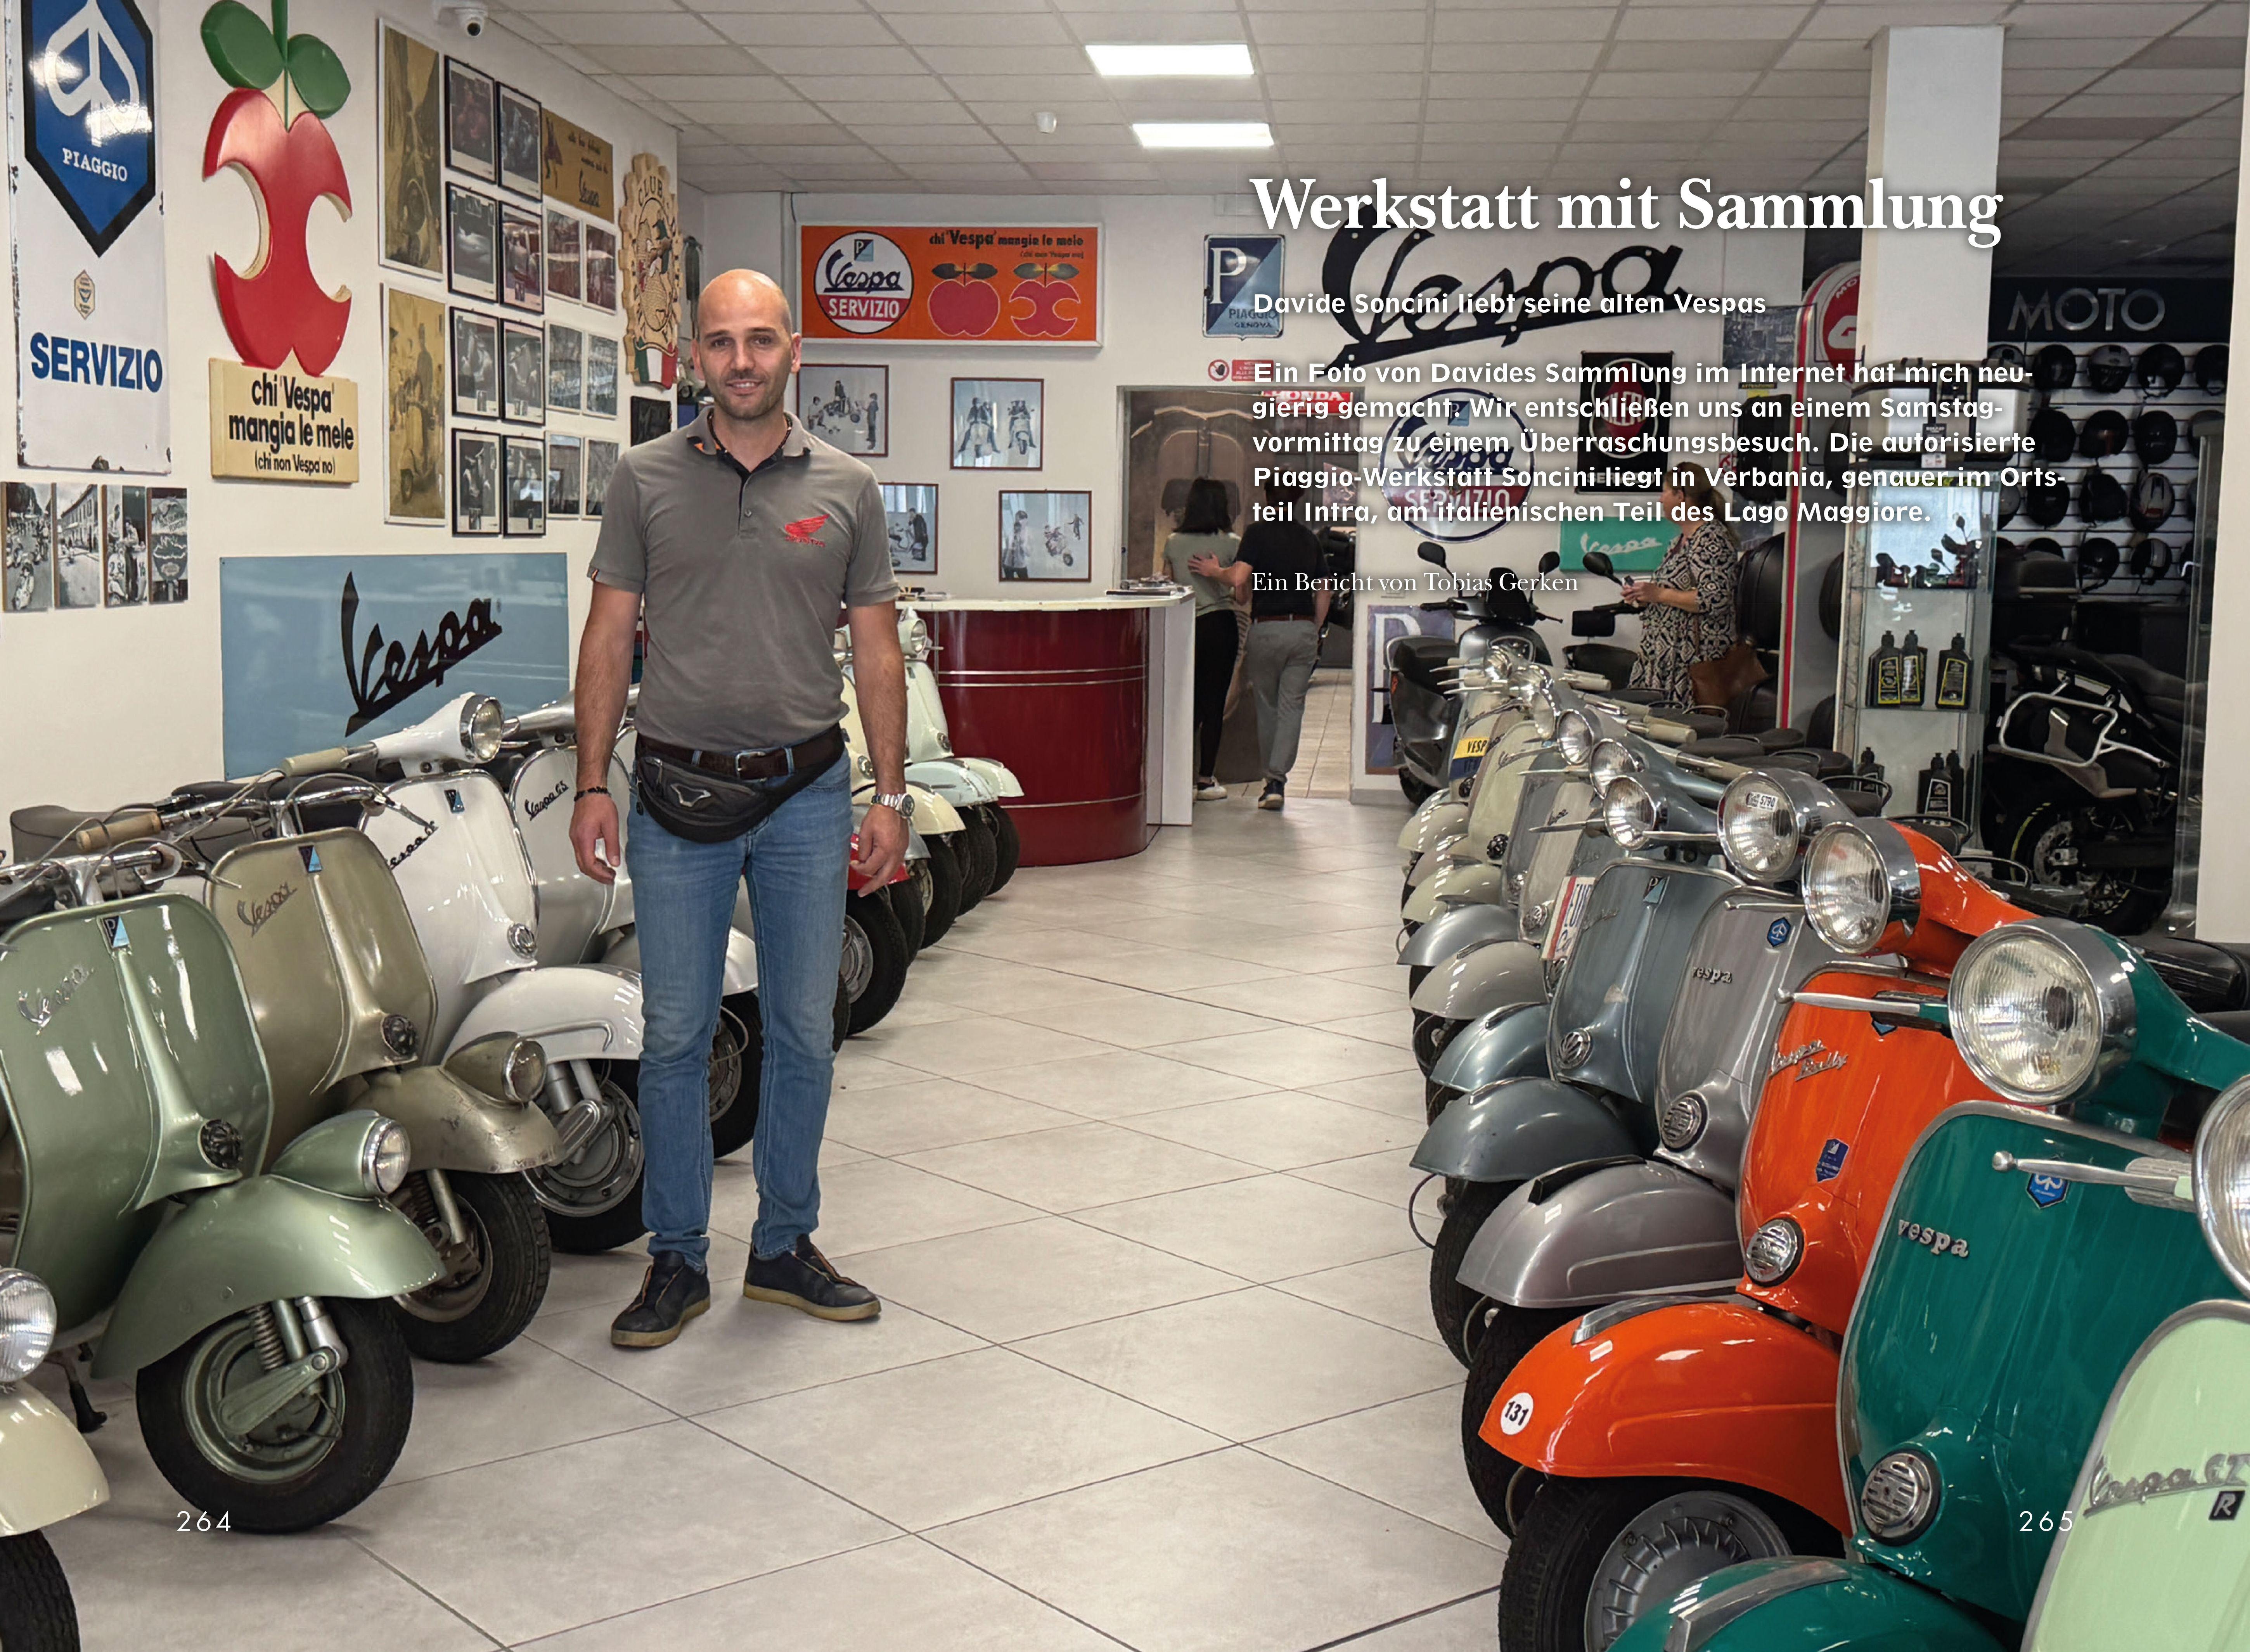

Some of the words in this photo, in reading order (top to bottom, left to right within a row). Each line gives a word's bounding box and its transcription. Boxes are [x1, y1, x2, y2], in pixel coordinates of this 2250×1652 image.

[62, 147, 127, 182] PIAGGIO
[639, 175, 663, 206] CLUB
[856, 240, 864, 254] P
[823, 249, 905, 295] Vespa
[1210, 247, 1247, 304] P
[829, 298, 900, 318] SERVIZIO
[1317, 204, 1722, 379] Vespa
[1229, 308, 1277, 319] PIAGGIO
[2008, 288, 2165, 331] MOTO
[31, 332, 163, 393] SERVIZIO
[251, 372, 277, 407] chi
[229, 412, 296, 454] mangia
[299, 414, 313, 446] le
[317, 417, 354, 450] mele
[1393, 412, 1520, 477] Vespa
[255, 450, 272, 472] (chi
[273, 458, 291, 471] non
[322, 457, 335, 475] no)
[1405, 488, 1511, 514] SERVIZIO
[1580, 532, 1663, 556] Vespa
[340, 571, 503, 737] Vespa
[1467, 739, 1488, 753] VESP
[524, 799, 557, 821] Vespa
[555, 780, 569, 796] GS
[237, 880, 298, 938] Vespa
[104, 919, 116, 938] P
[1898, 1219, 1969, 1257] vespa
[1504, 1401, 1528, 1426] 131
[2083, 1455, 2199, 1517] Vespa
[2214, 1495, 2236, 1516] R
